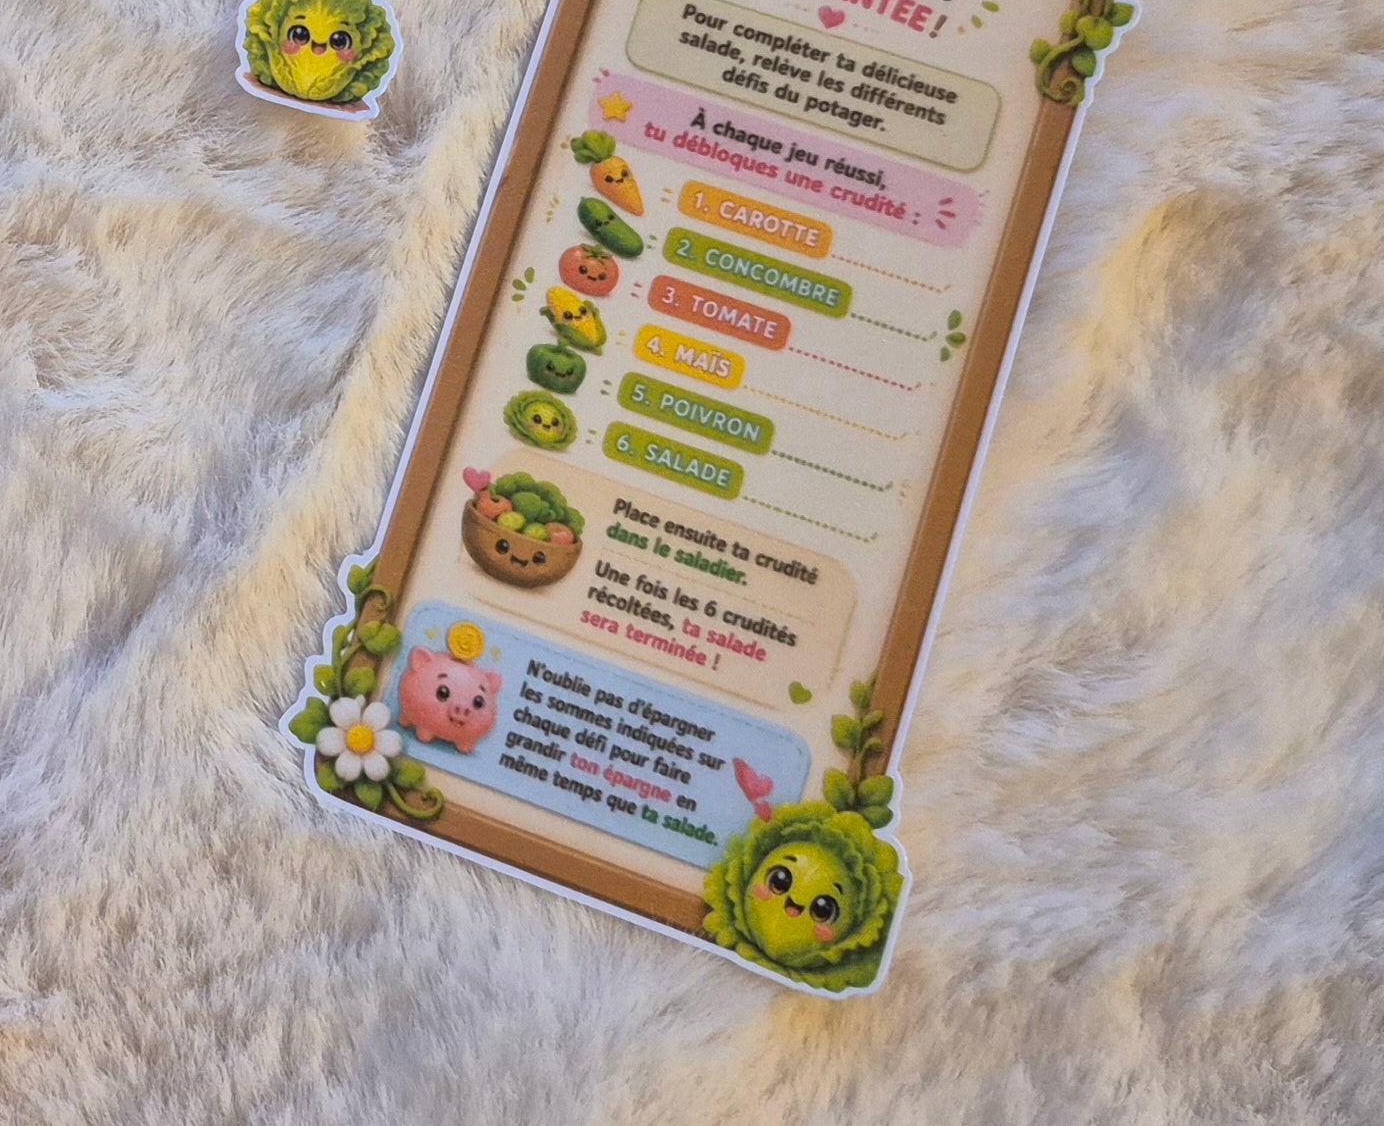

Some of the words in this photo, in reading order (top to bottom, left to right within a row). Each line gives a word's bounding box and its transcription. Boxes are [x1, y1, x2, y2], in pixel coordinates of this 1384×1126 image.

[679, 29, 746, 64] salade,
[751, 51, 813, 84] relève
[818, 69, 845, 93] les
[850, 77, 947, 126] différents
[682, 4, 728, 32] Pour
[733, 17, 831, 65] compléter
[836, 47, 858, 71] ta
[863, 56, 958, 105] délicieuse
[722, 67, 769, 96] défis
[774, 82, 800, 104] du
[803, 91, 887, 134] potager.
[644, 121, 668, 143] tu
[672, 130, 780, 181] débloques
[785, 166, 824, 193] une
[829, 178, 909, 220] crudité
[690, 107, 707, 129] À
[712, 116, 784, 157] chaque
[783, 141, 818, 168] jeu
[824, 154, 888, 191] réussi,
[719, 199, 821, 247] CAROTTE
[704, 247, 840, 307] CONCOMBRE
[691, 295, 779, 339] TOMATE
[674, 343, 732, 377] MAÏS
[659, 393, 761, 442] POIVRON
[644, 443, 731, 488] SALADE
[605, 522, 650, 553] dans
[653, 537, 671, 559] le
[674, 544, 748, 587] saladier.
[613, 498, 660, 530] Place
[663, 516, 728, 552] ensuite
[731, 538, 751, 561] ta
[754, 546, 820, 585] crudité
[580, 608, 620, 634] sera
[625, 622, 708, 667] terminée
[587, 583, 675, 631] récoltées,
[681, 617, 702, 640] ta
[705, 625, 768, 662] salade
[594, 560, 631, 588] Une
[635, 570, 669, 601] fois
[672, 588, 699, 612] les
[704, 599, 718, 618] 6
[722, 605, 797, 647] crudités
[519, 682, 543, 707] les
[546, 696, 613, 729] sommes
[617, 717, 696, 762] indiquées
[699, 751, 725, 771] sur
[593, 685, 624, 713] pas
[505, 728, 567, 763] grandir
[570, 752, 600, 773] ton
[602, 760, 673, 806] épargne
[676, 794, 697, 812] en
[513, 707, 573, 743] chaque
[575, 724, 607, 752] défi
[608, 740, 650, 770] pour
[653, 755, 692, 786] faire
[498, 751, 549, 783] même
[553, 771, 603, 801] temps
[606, 793, 637, 817] que
[641, 804, 659, 823] ta
[662, 812, 718, 846] salade.
